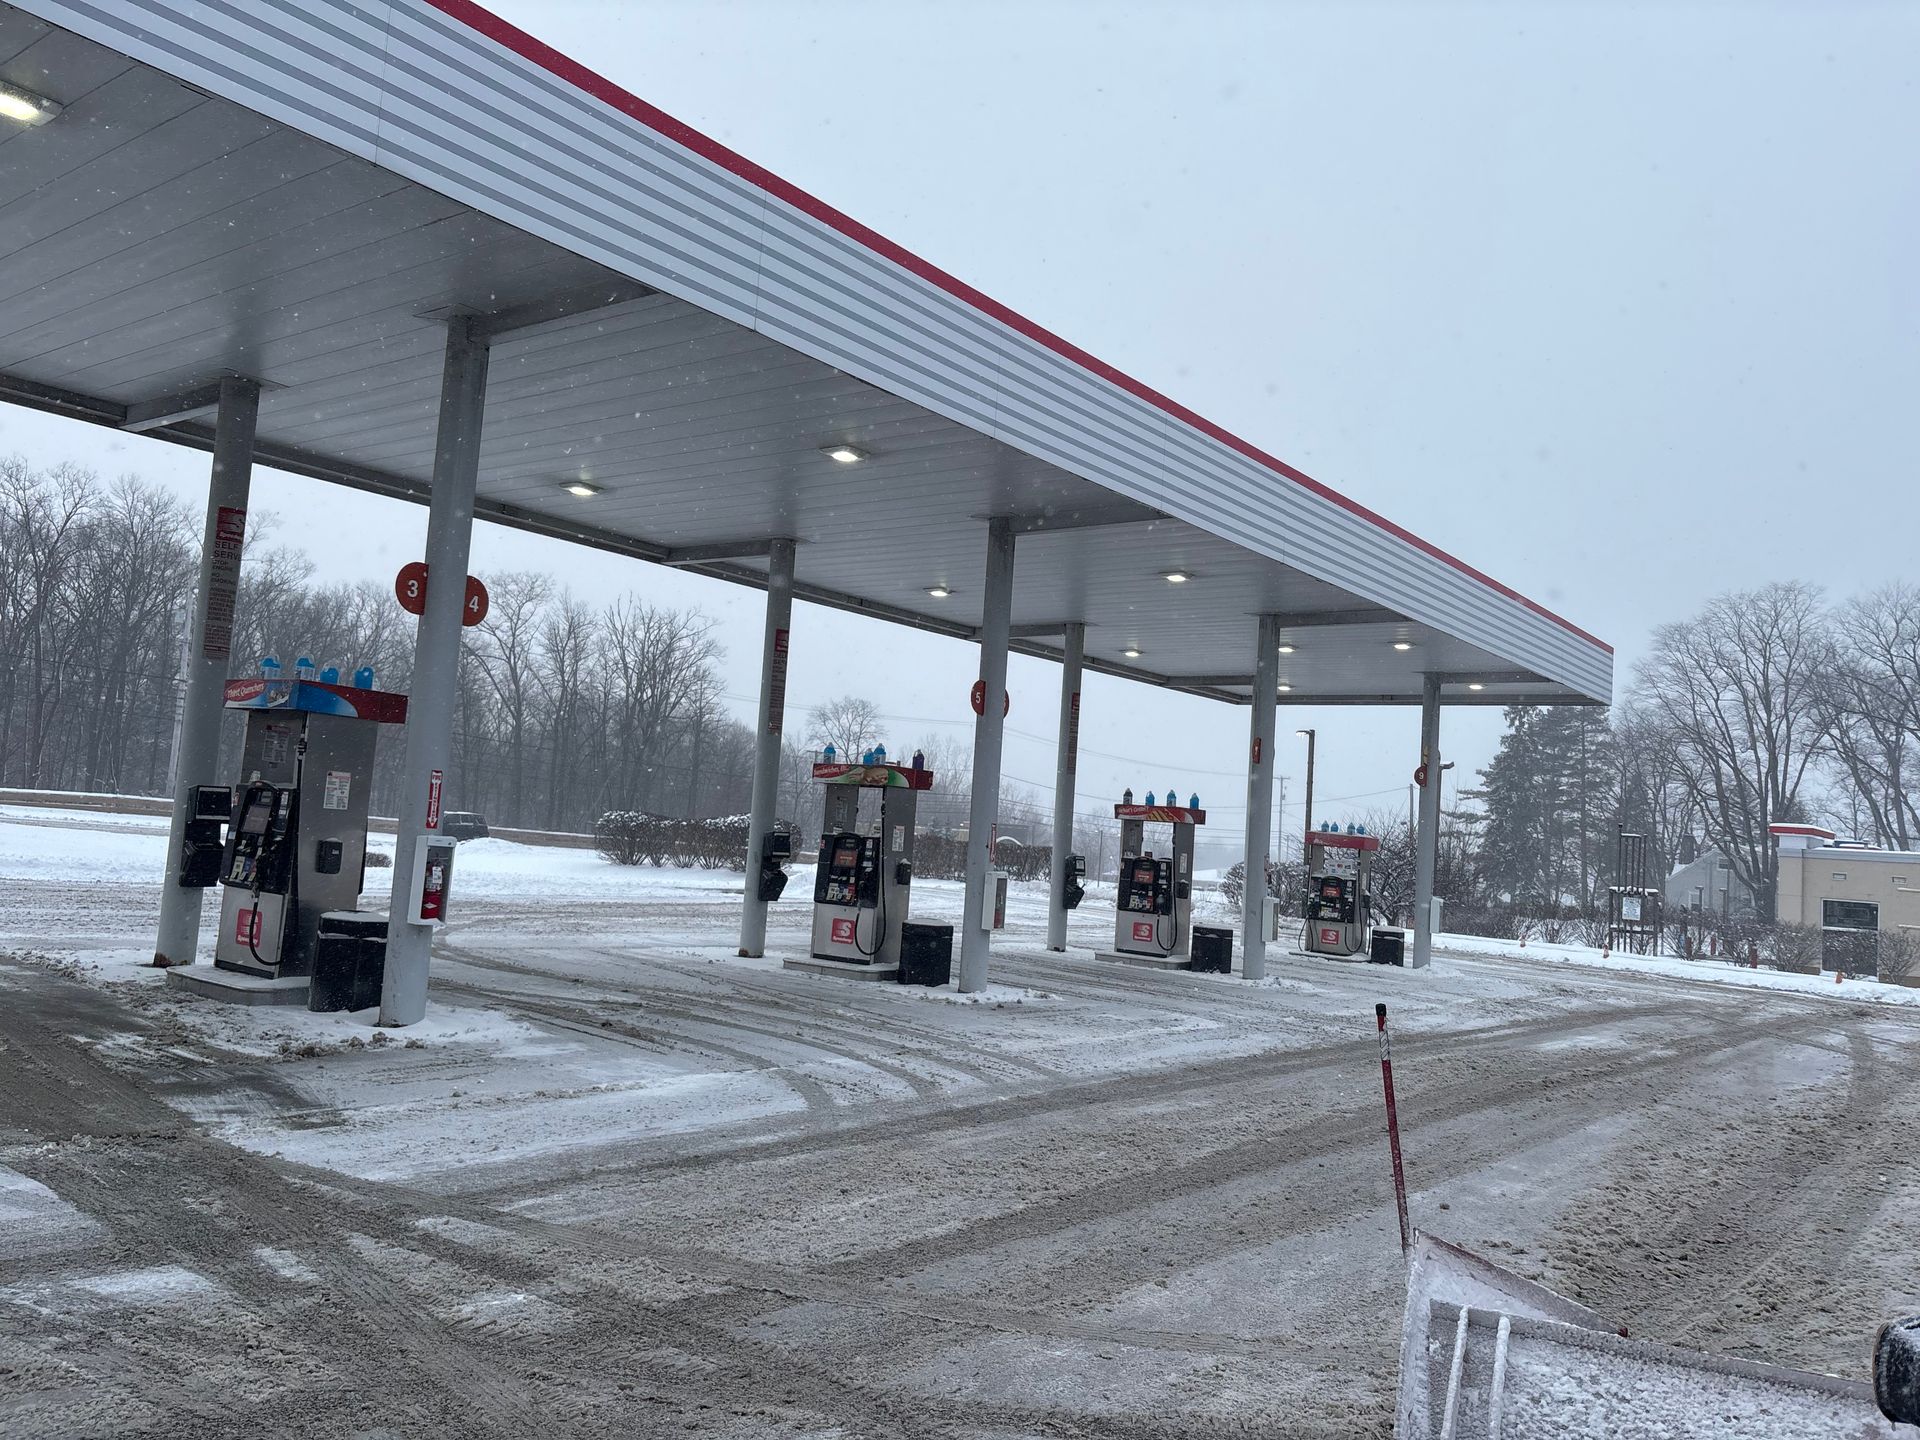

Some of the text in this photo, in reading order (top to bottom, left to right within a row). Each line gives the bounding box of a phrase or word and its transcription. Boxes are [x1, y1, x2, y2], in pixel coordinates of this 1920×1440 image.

[215, 541, 239, 551] SELF
[407, 580, 418, 598] 3
[468, 595, 479, 613] 4
[975, 692, 981, 704] 5
[1418, 771, 1424, 780] 9
